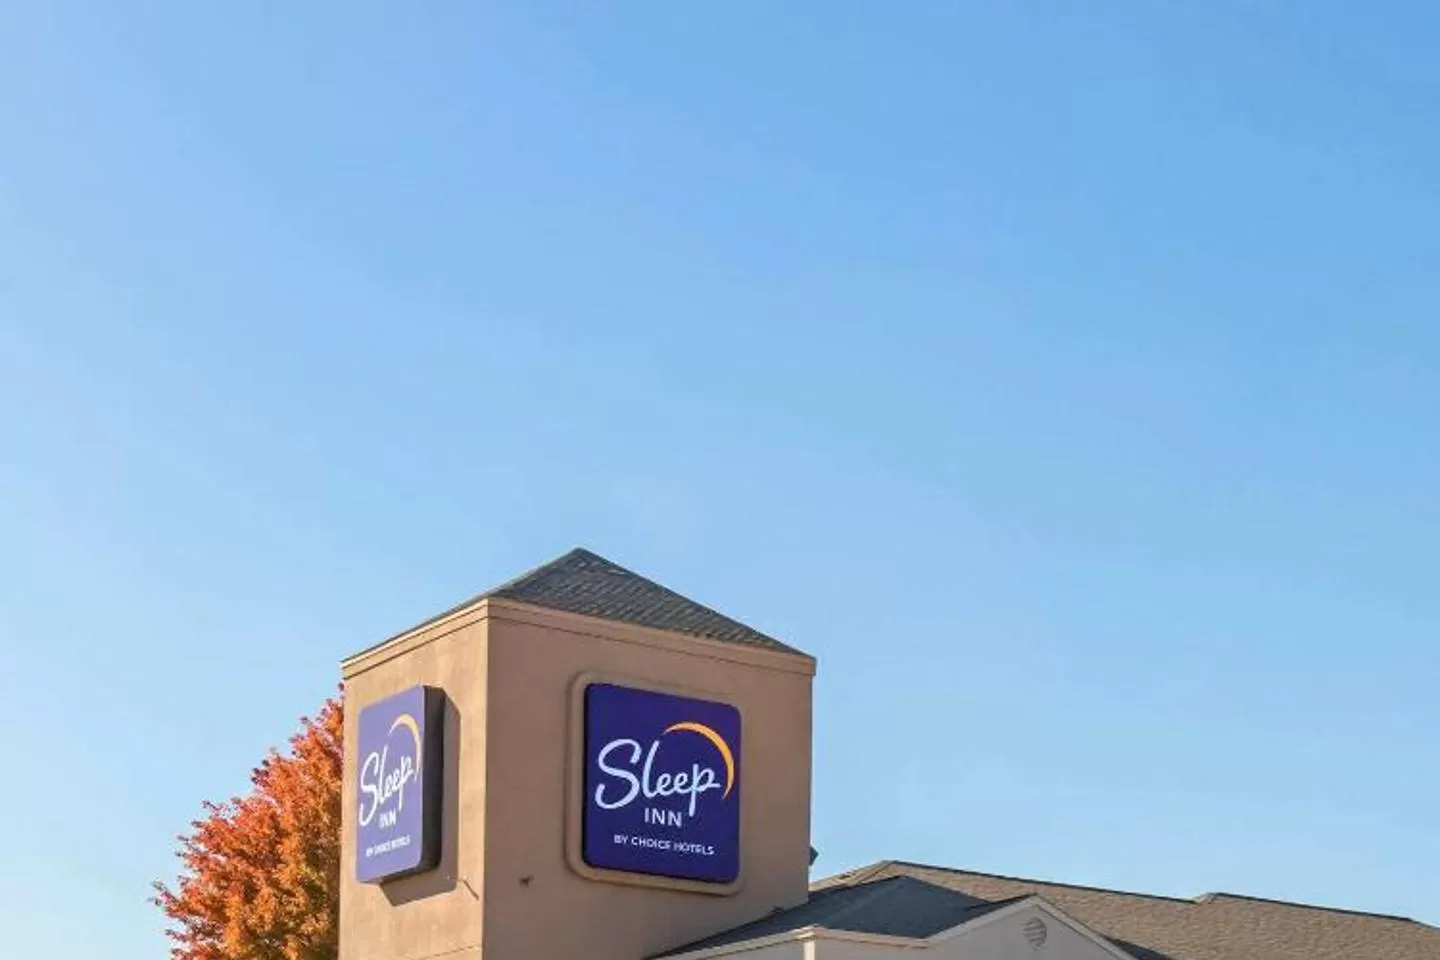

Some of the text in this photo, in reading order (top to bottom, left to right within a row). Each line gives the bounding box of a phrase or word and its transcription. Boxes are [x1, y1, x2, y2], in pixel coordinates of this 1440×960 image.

[359, 744, 414, 826] Sleep
[595, 738, 721, 817] Sleep
[644, 807, 682, 828] INN
[613, 833, 715, 856] BY CHOICE HOTELS
